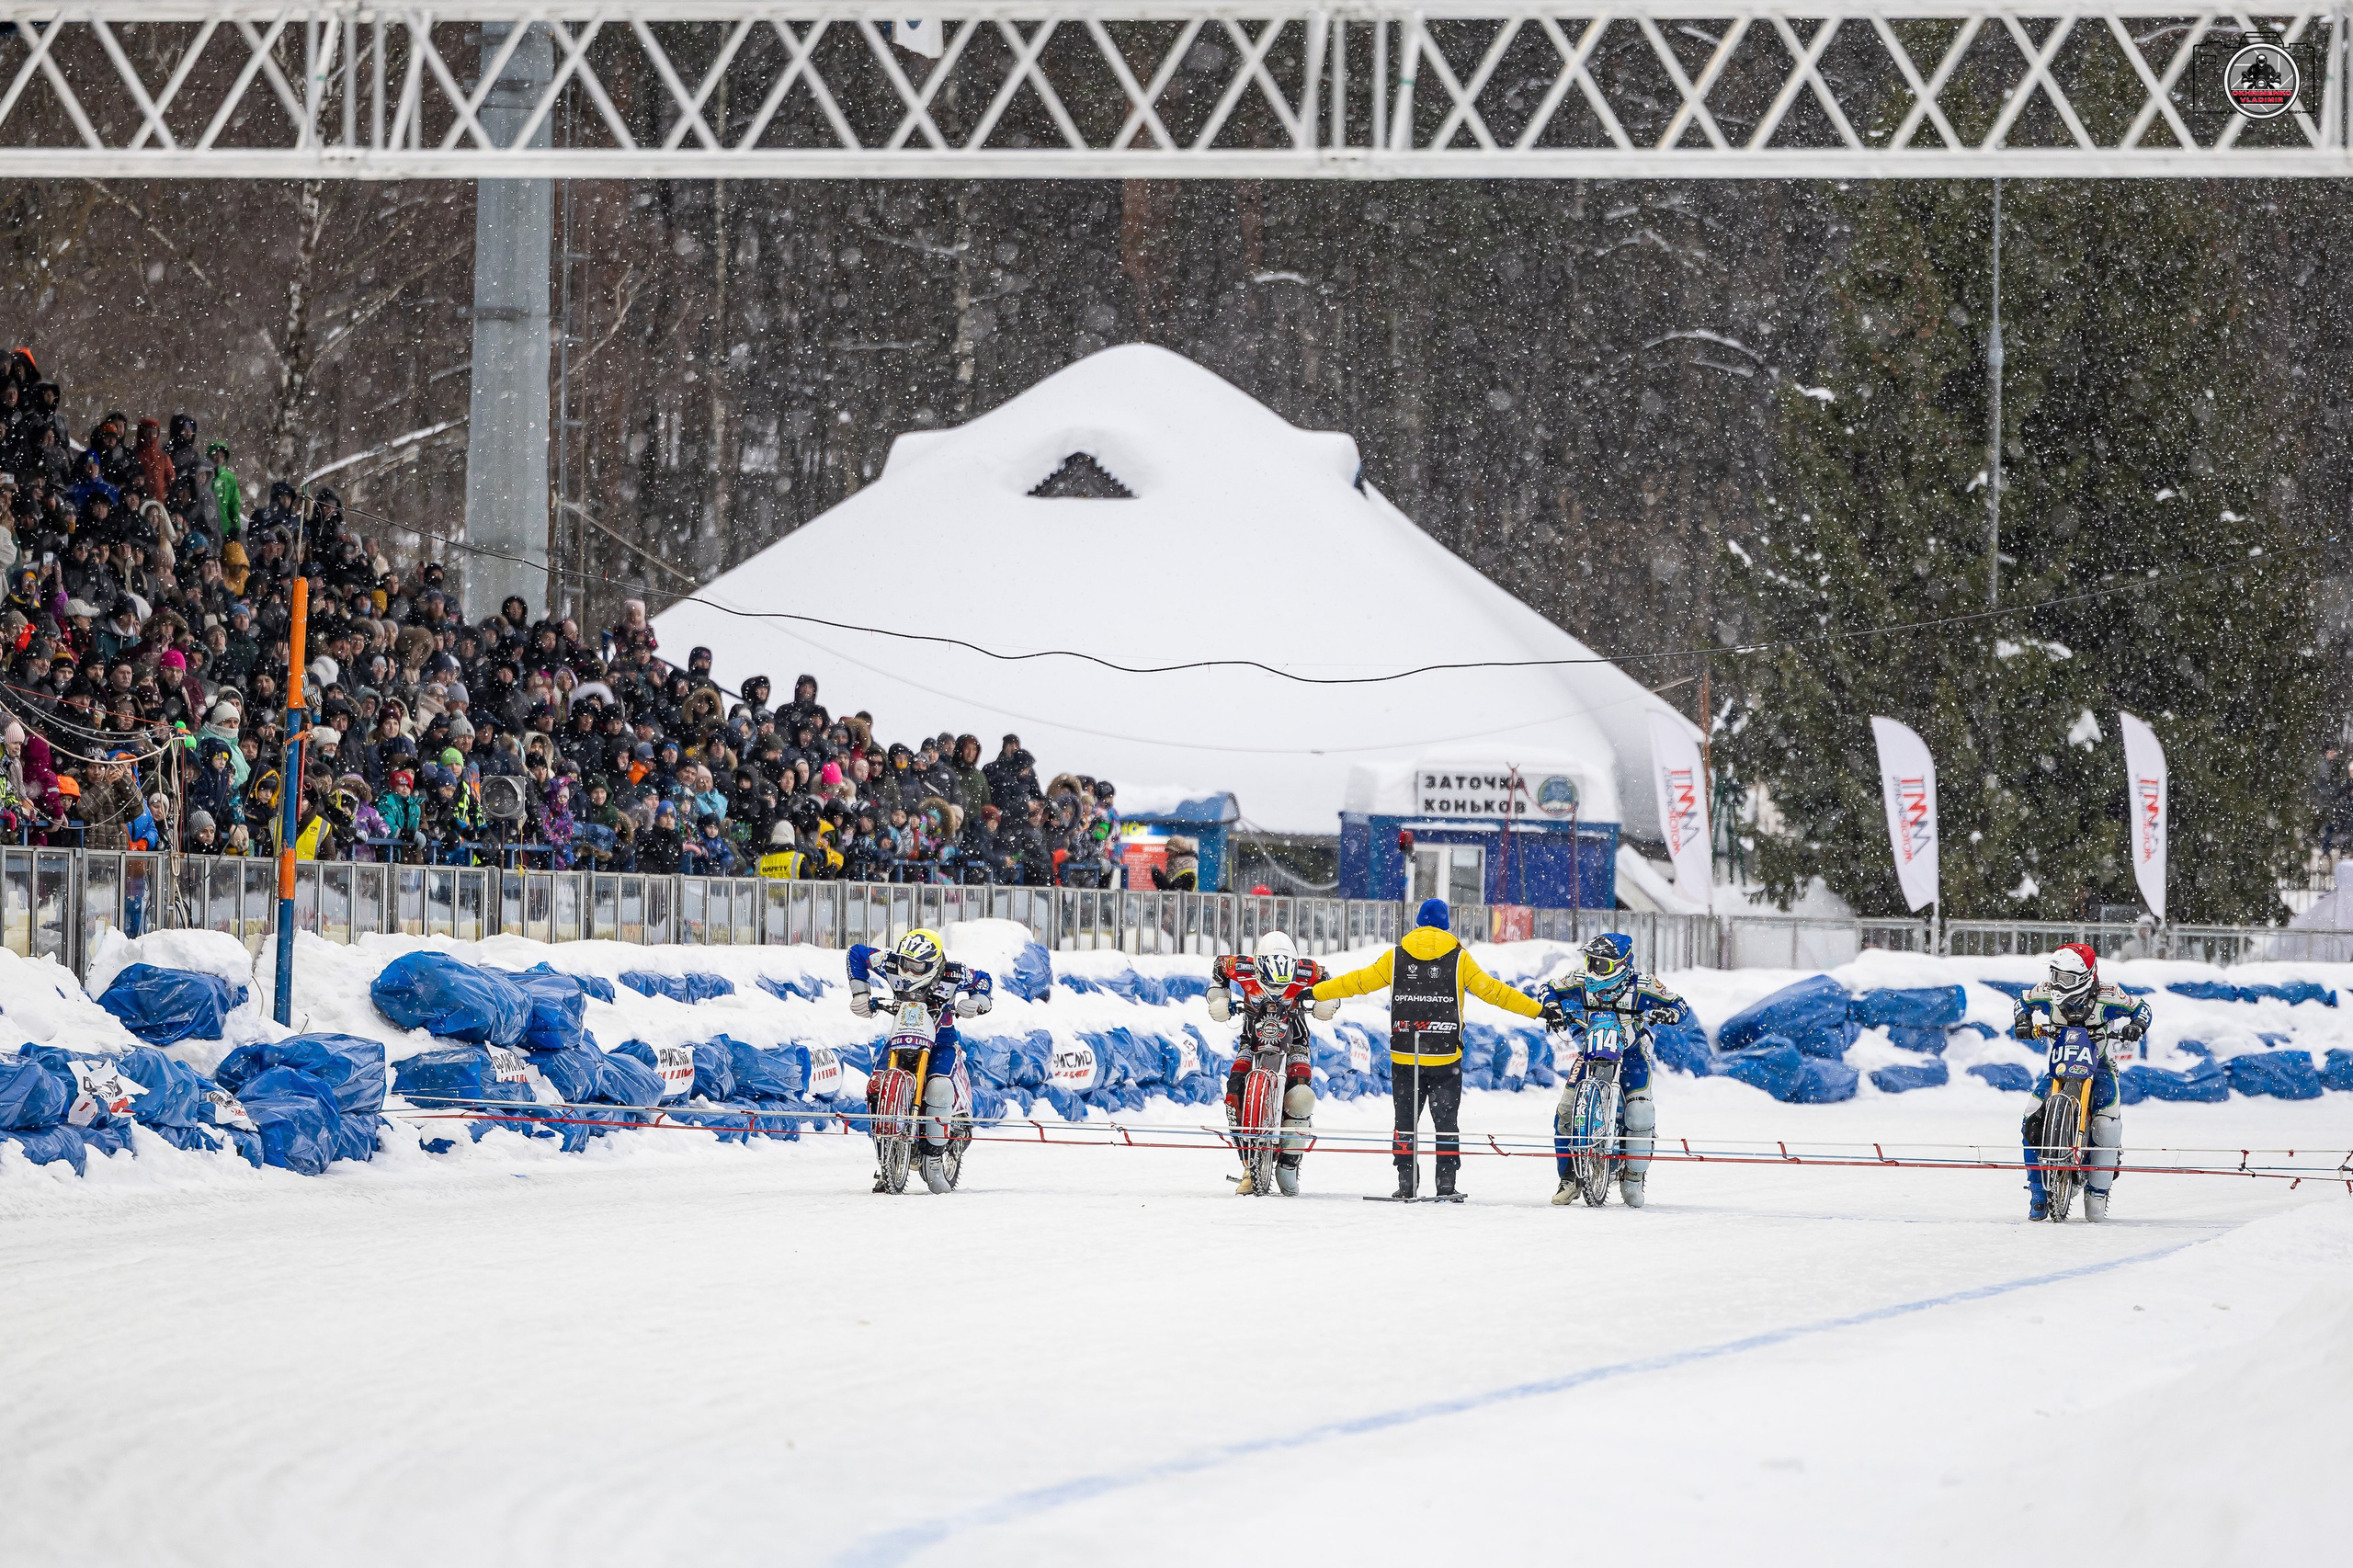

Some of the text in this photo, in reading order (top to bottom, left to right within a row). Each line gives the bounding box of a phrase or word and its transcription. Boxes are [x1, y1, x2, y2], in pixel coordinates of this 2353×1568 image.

[1425, 776, 1526, 790] ЗАТОЧКА
[1425, 799, 1526, 814] КОНЬКОВ
[1394, 994, 1454, 1003] ОРГАНИЗАТОР
[1427, 1021, 1458, 1030] RGP
[1586, 1028, 1618, 1053] 114
[2052, 1045, 2094, 1065] UFA
[1568, 1056, 1586, 1085] MOTU
